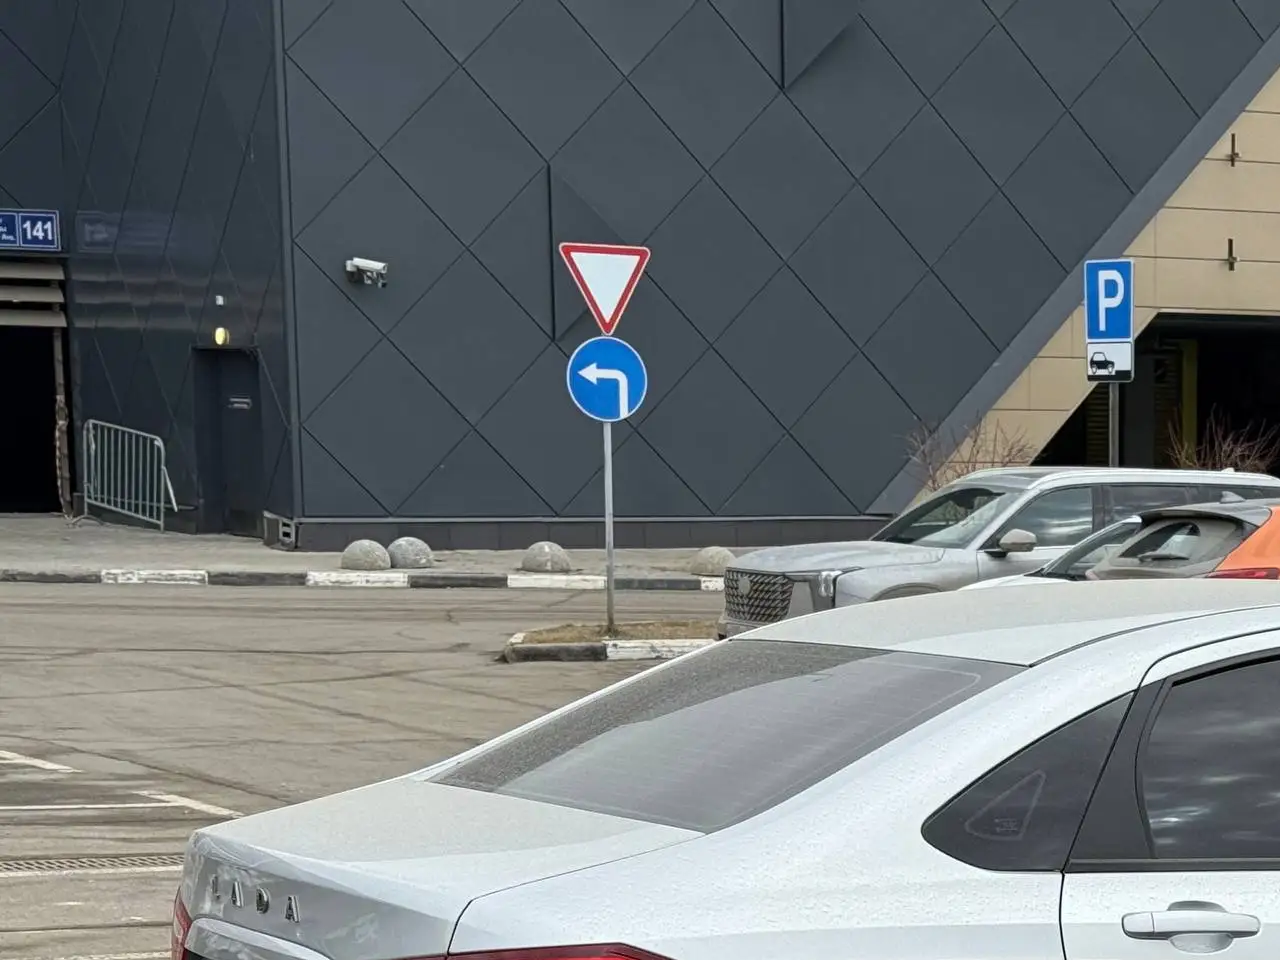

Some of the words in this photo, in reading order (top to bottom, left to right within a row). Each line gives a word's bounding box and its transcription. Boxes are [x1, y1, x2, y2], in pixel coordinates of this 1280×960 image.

[22, 219, 53, 240] 141
[1097, 269, 1125, 332] P
[210, 873, 300, 924] LADA
